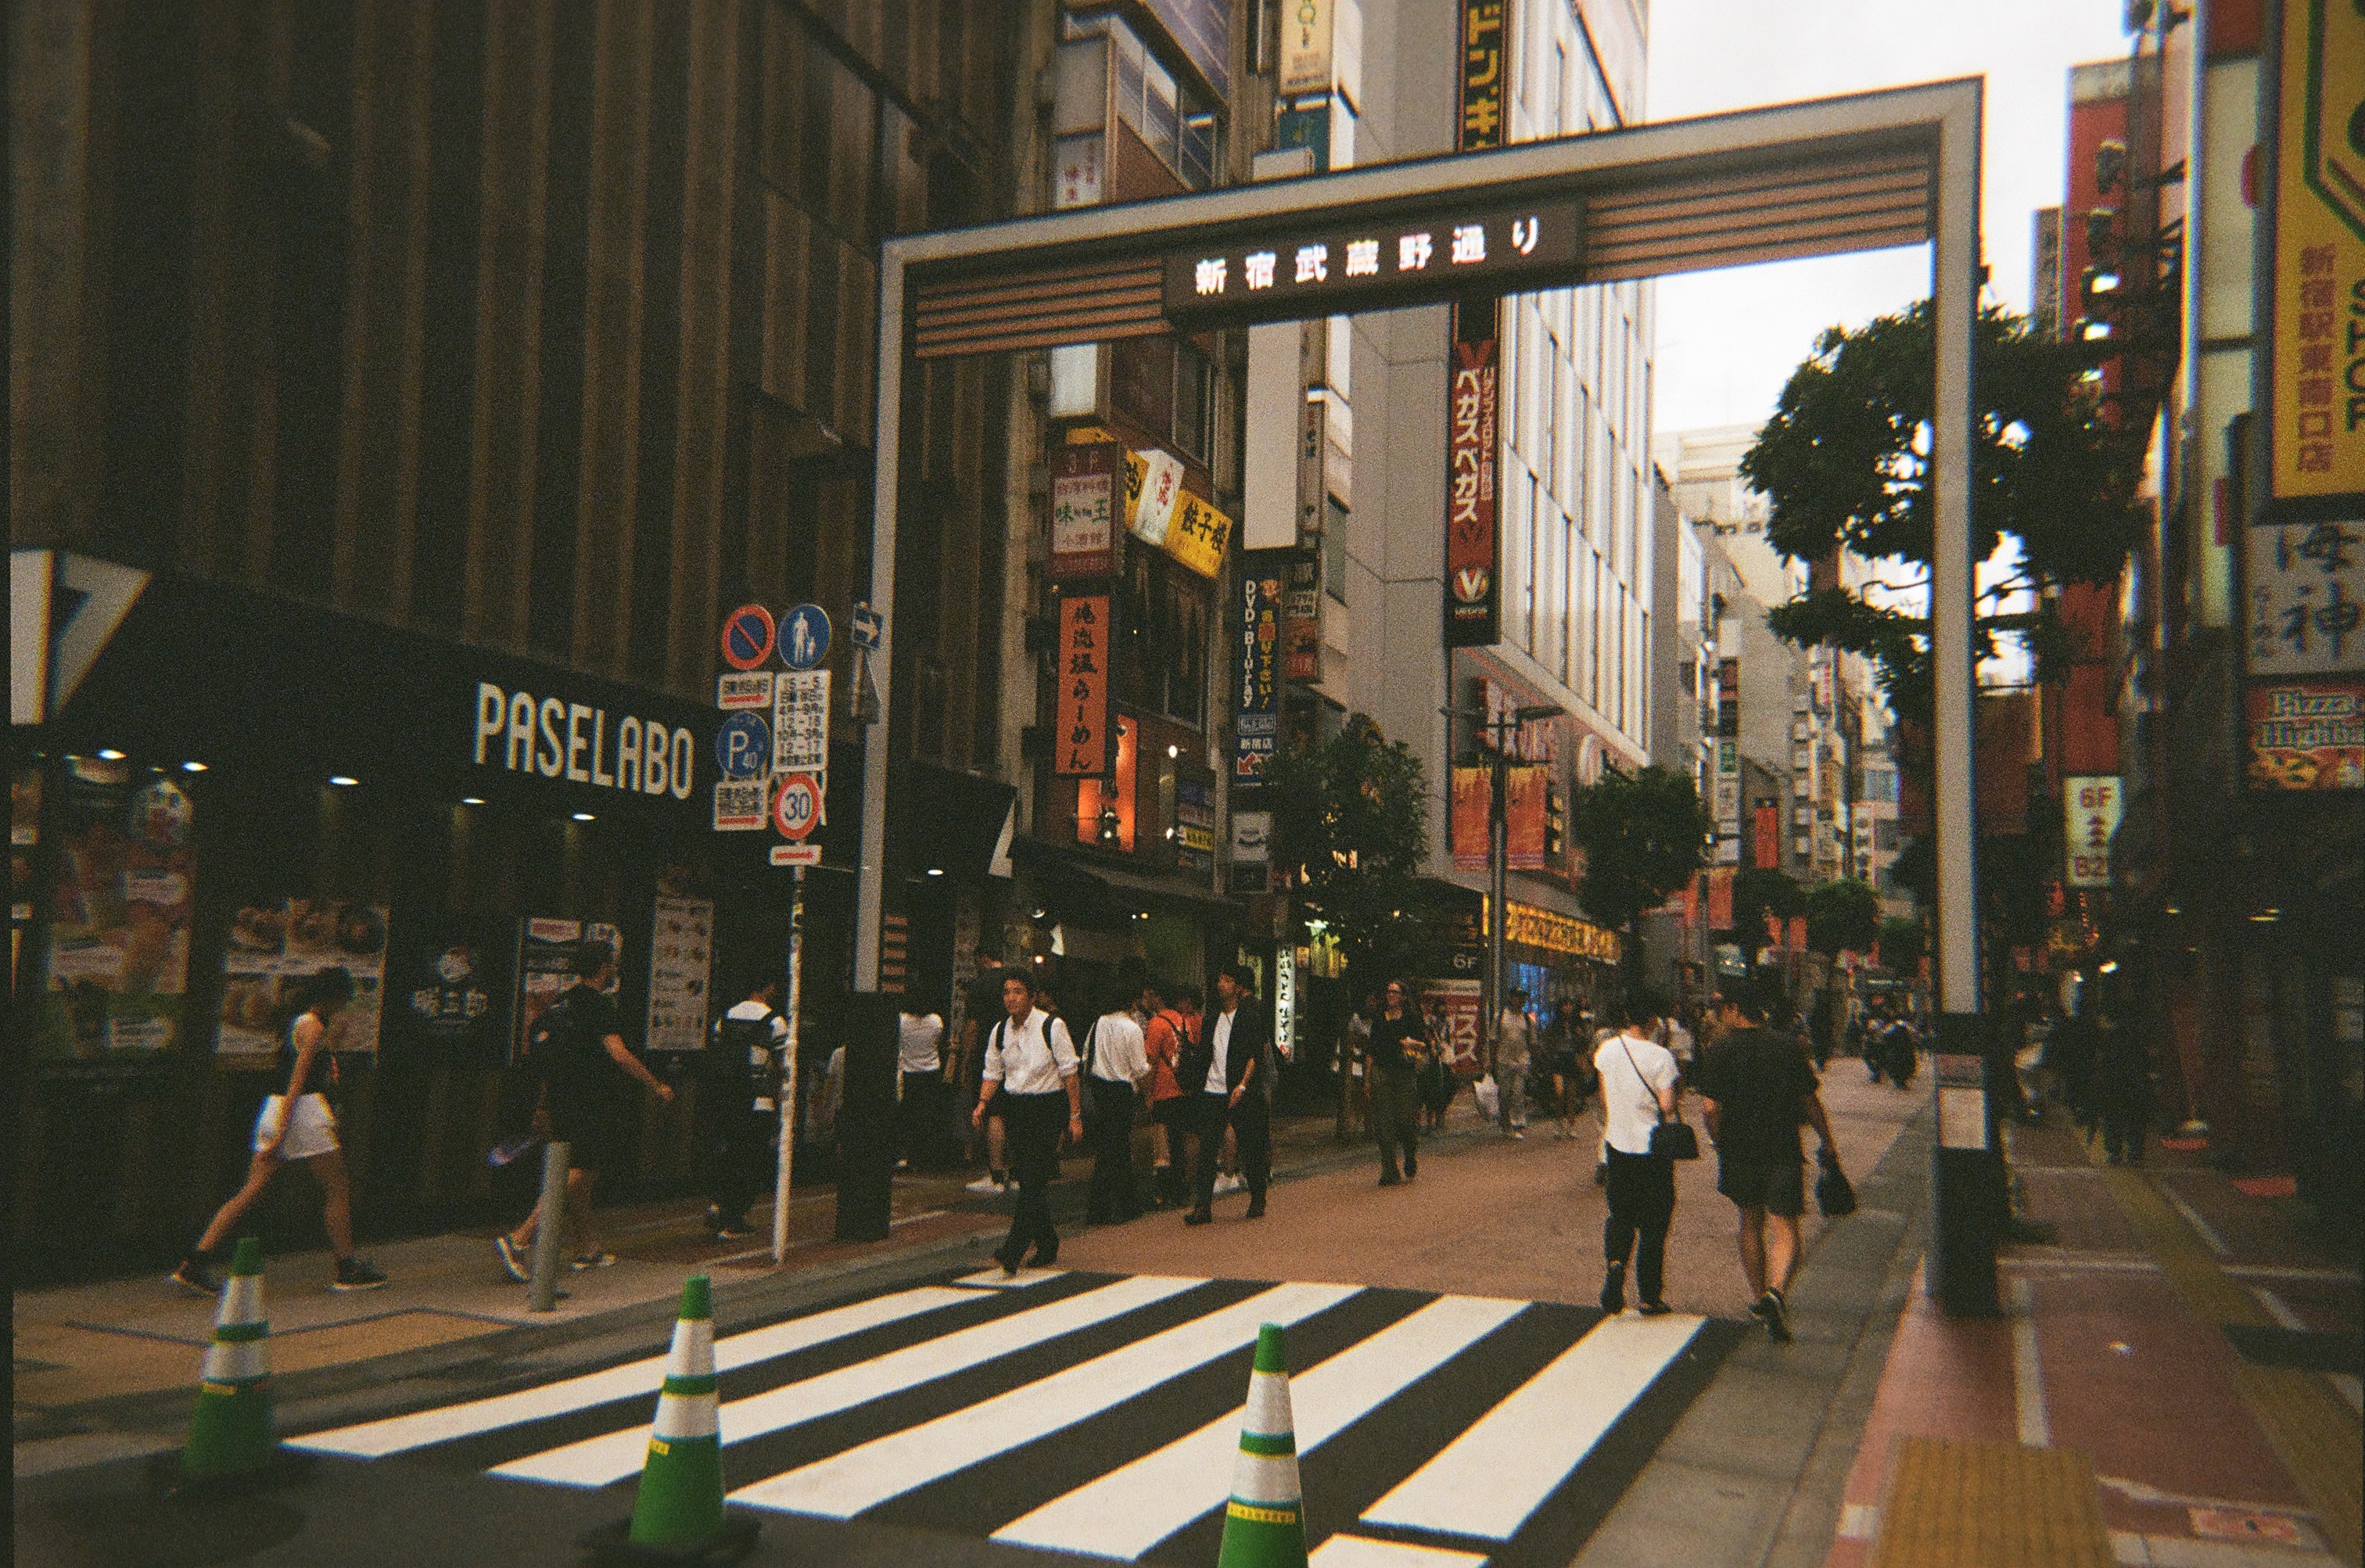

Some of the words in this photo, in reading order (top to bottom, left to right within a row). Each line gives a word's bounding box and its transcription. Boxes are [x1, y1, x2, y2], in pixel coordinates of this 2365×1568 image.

[1195, 216, 1539, 296] 新宿武蔵野通り
[1454, 368, 1480, 522] ベガスベガス
[474, 680, 694, 799] PASELABO
[728, 730, 749, 770] P
[784, 791, 812, 821] 30
[2080, 786, 2112, 809] 6F
[1453, 953, 1478, 970] 6F
